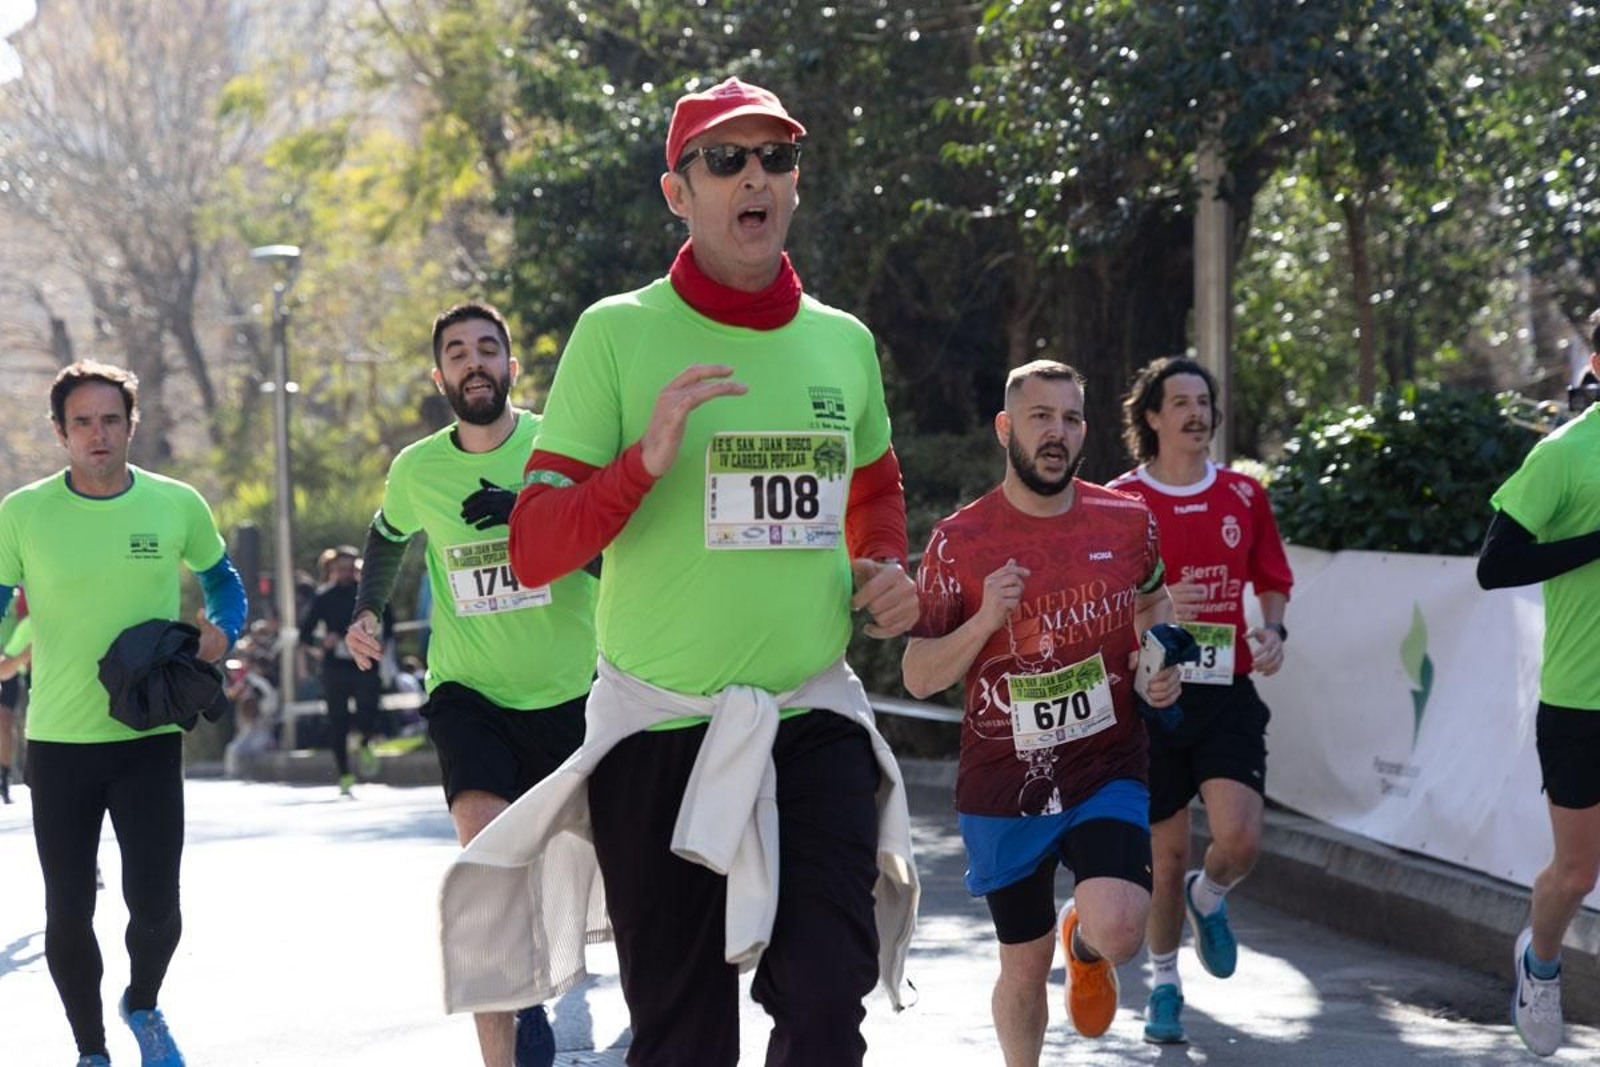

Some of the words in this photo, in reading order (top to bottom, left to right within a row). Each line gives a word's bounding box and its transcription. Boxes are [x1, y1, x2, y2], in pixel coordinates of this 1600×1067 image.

[731, 453, 768, 470] CARRERA
[771, 453, 806, 469] POPULAR
[736, 437, 754, 451] SAN
[758, 437, 783, 451] JUAN
[786, 437, 812, 451] BOSCO
[750, 474, 819, 520] 108
[473, 564, 519, 597] 174
[1022, 579, 1108, 619] MEDIO
[1034, 691, 1092, 731] 670
